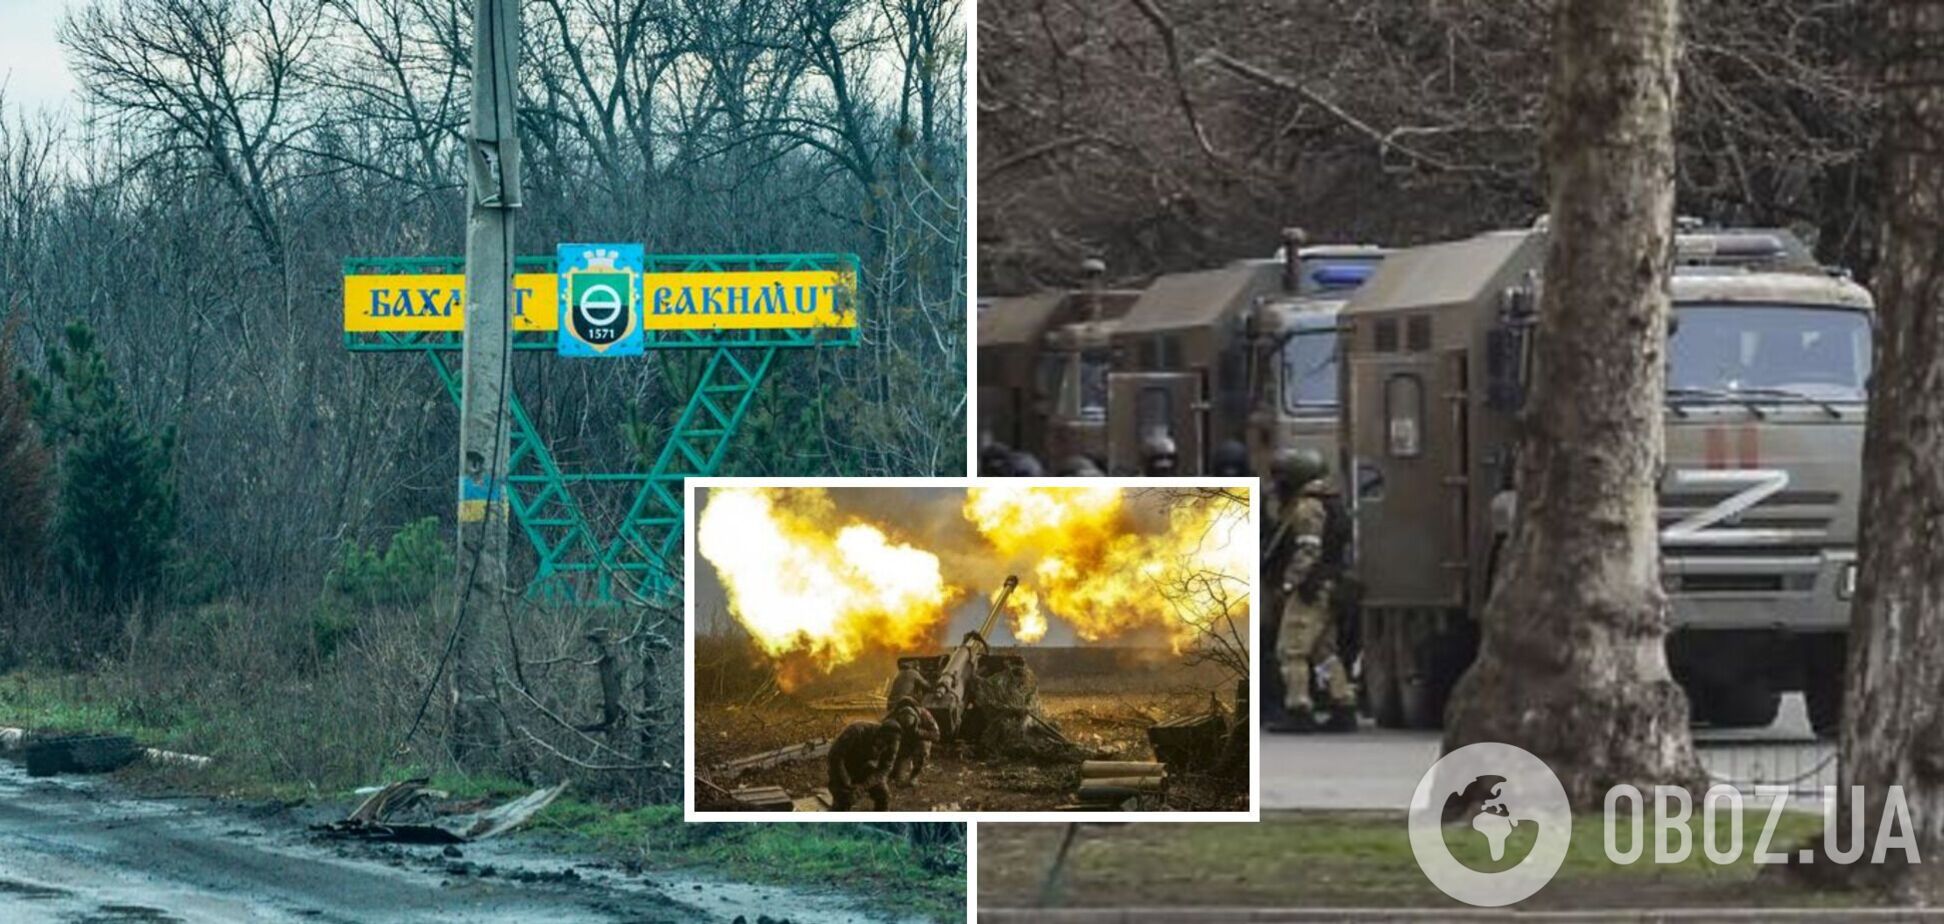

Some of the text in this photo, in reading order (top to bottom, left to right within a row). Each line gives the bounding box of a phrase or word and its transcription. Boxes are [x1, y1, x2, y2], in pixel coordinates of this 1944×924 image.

[370, 288, 533, 317] БАХТ
[589, 328, 614, 339] 1571
[1661, 469, 1790, 544] Z
